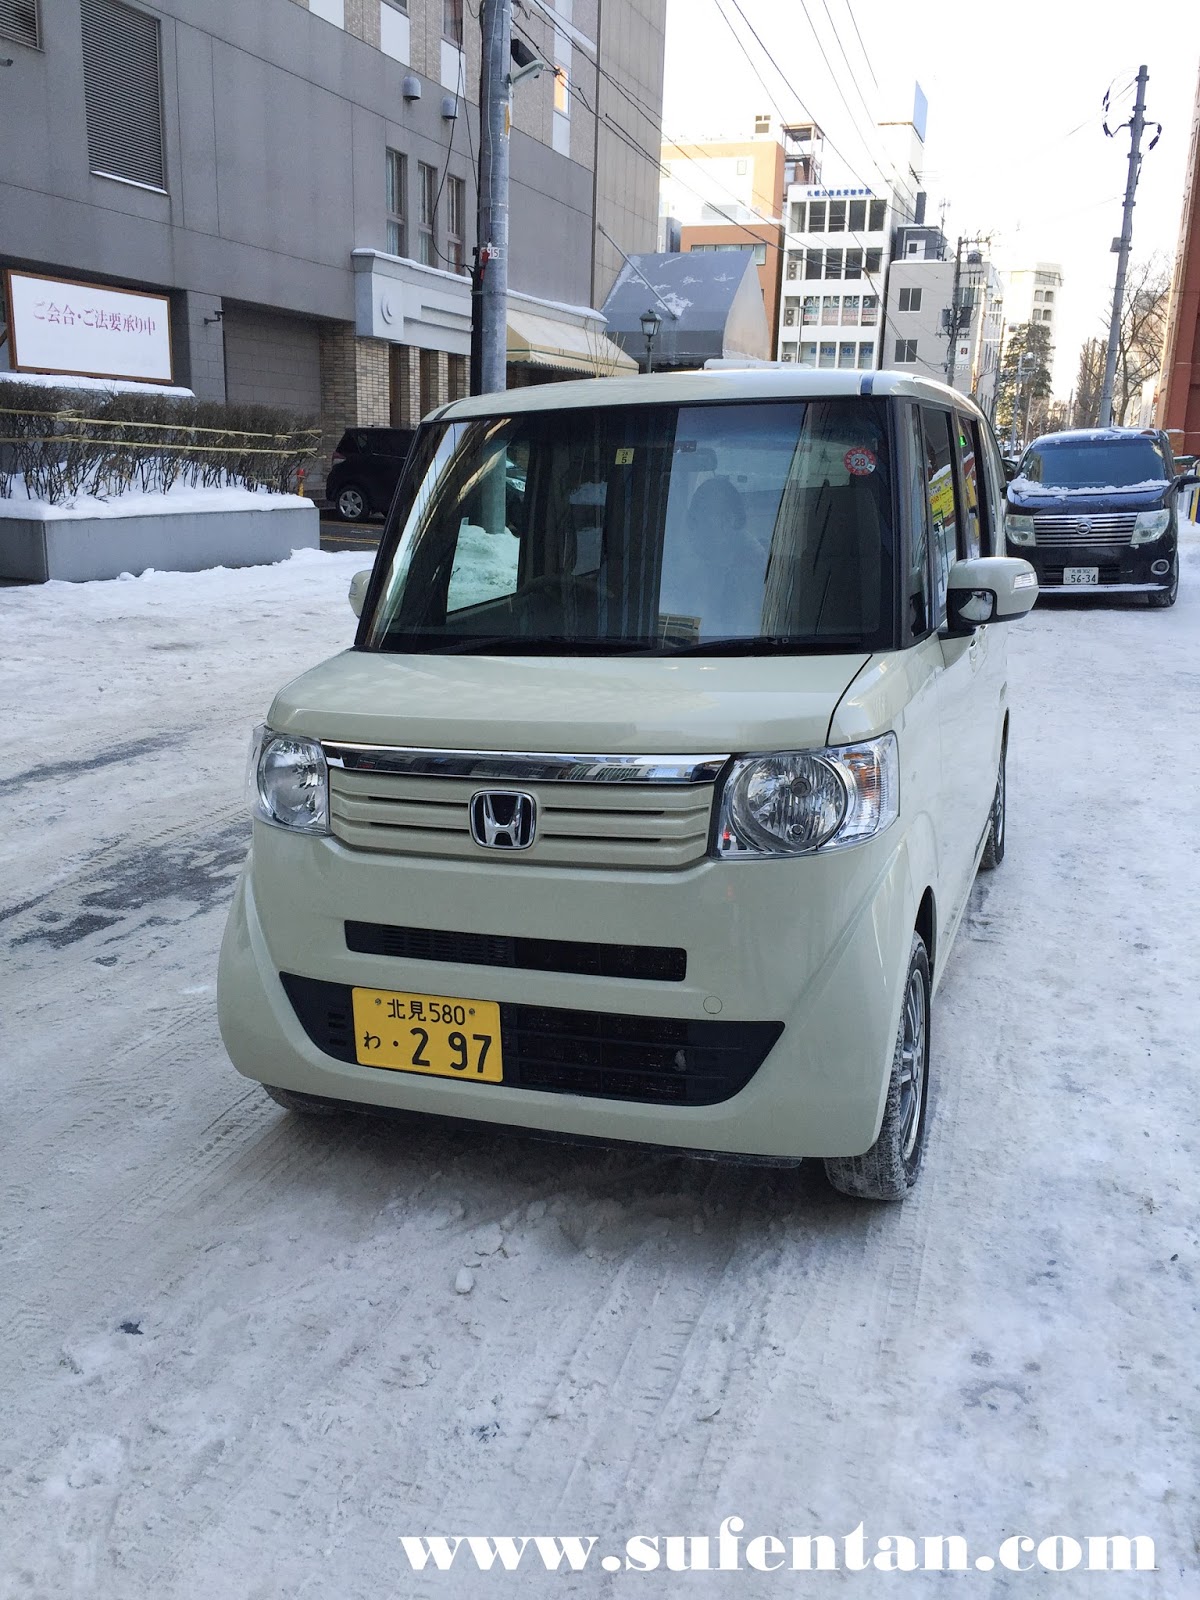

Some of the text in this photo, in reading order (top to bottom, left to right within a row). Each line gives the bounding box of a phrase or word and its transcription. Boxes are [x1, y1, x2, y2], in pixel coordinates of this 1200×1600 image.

[32, 301, 156, 336] ご会合・ご法要承り中
[854, 457, 866, 467] 28
[1071, 574, 1096, 583] 56-34
